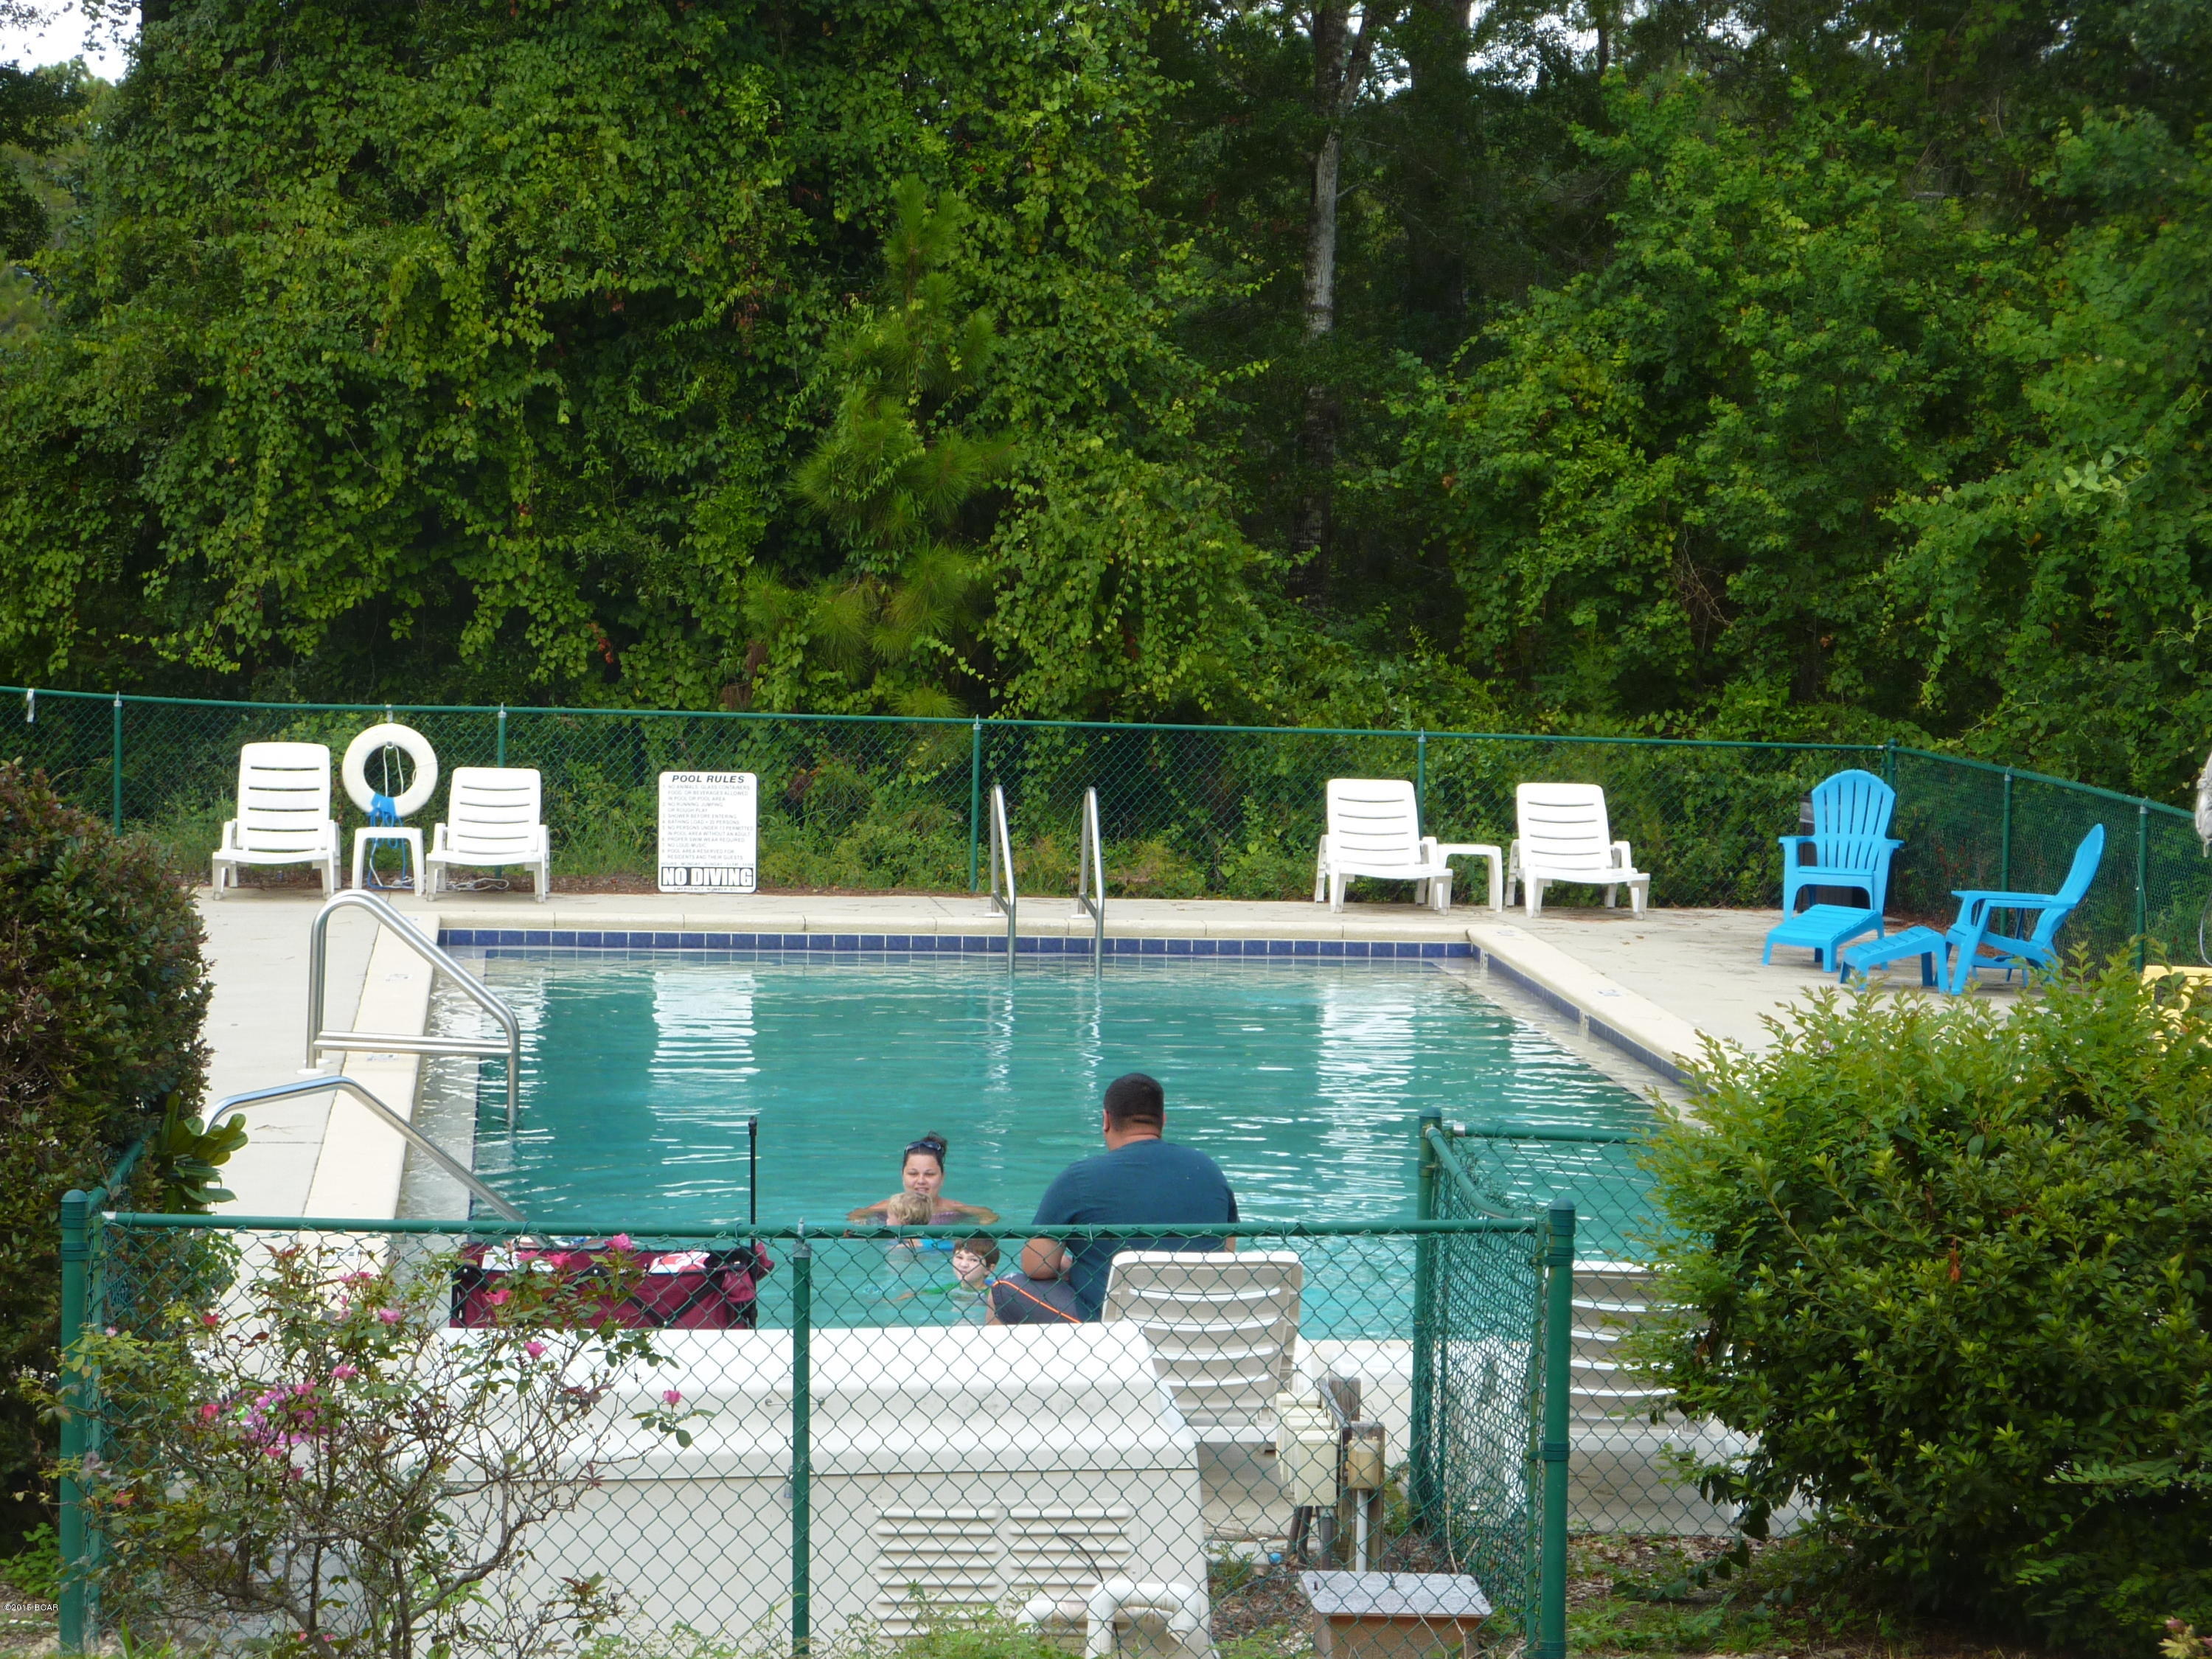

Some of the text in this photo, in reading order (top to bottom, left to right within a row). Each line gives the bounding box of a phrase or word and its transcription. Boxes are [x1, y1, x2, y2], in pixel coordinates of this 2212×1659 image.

[706, 775, 745, 783] RULES
[662, 867, 752, 886] NO DIVING
